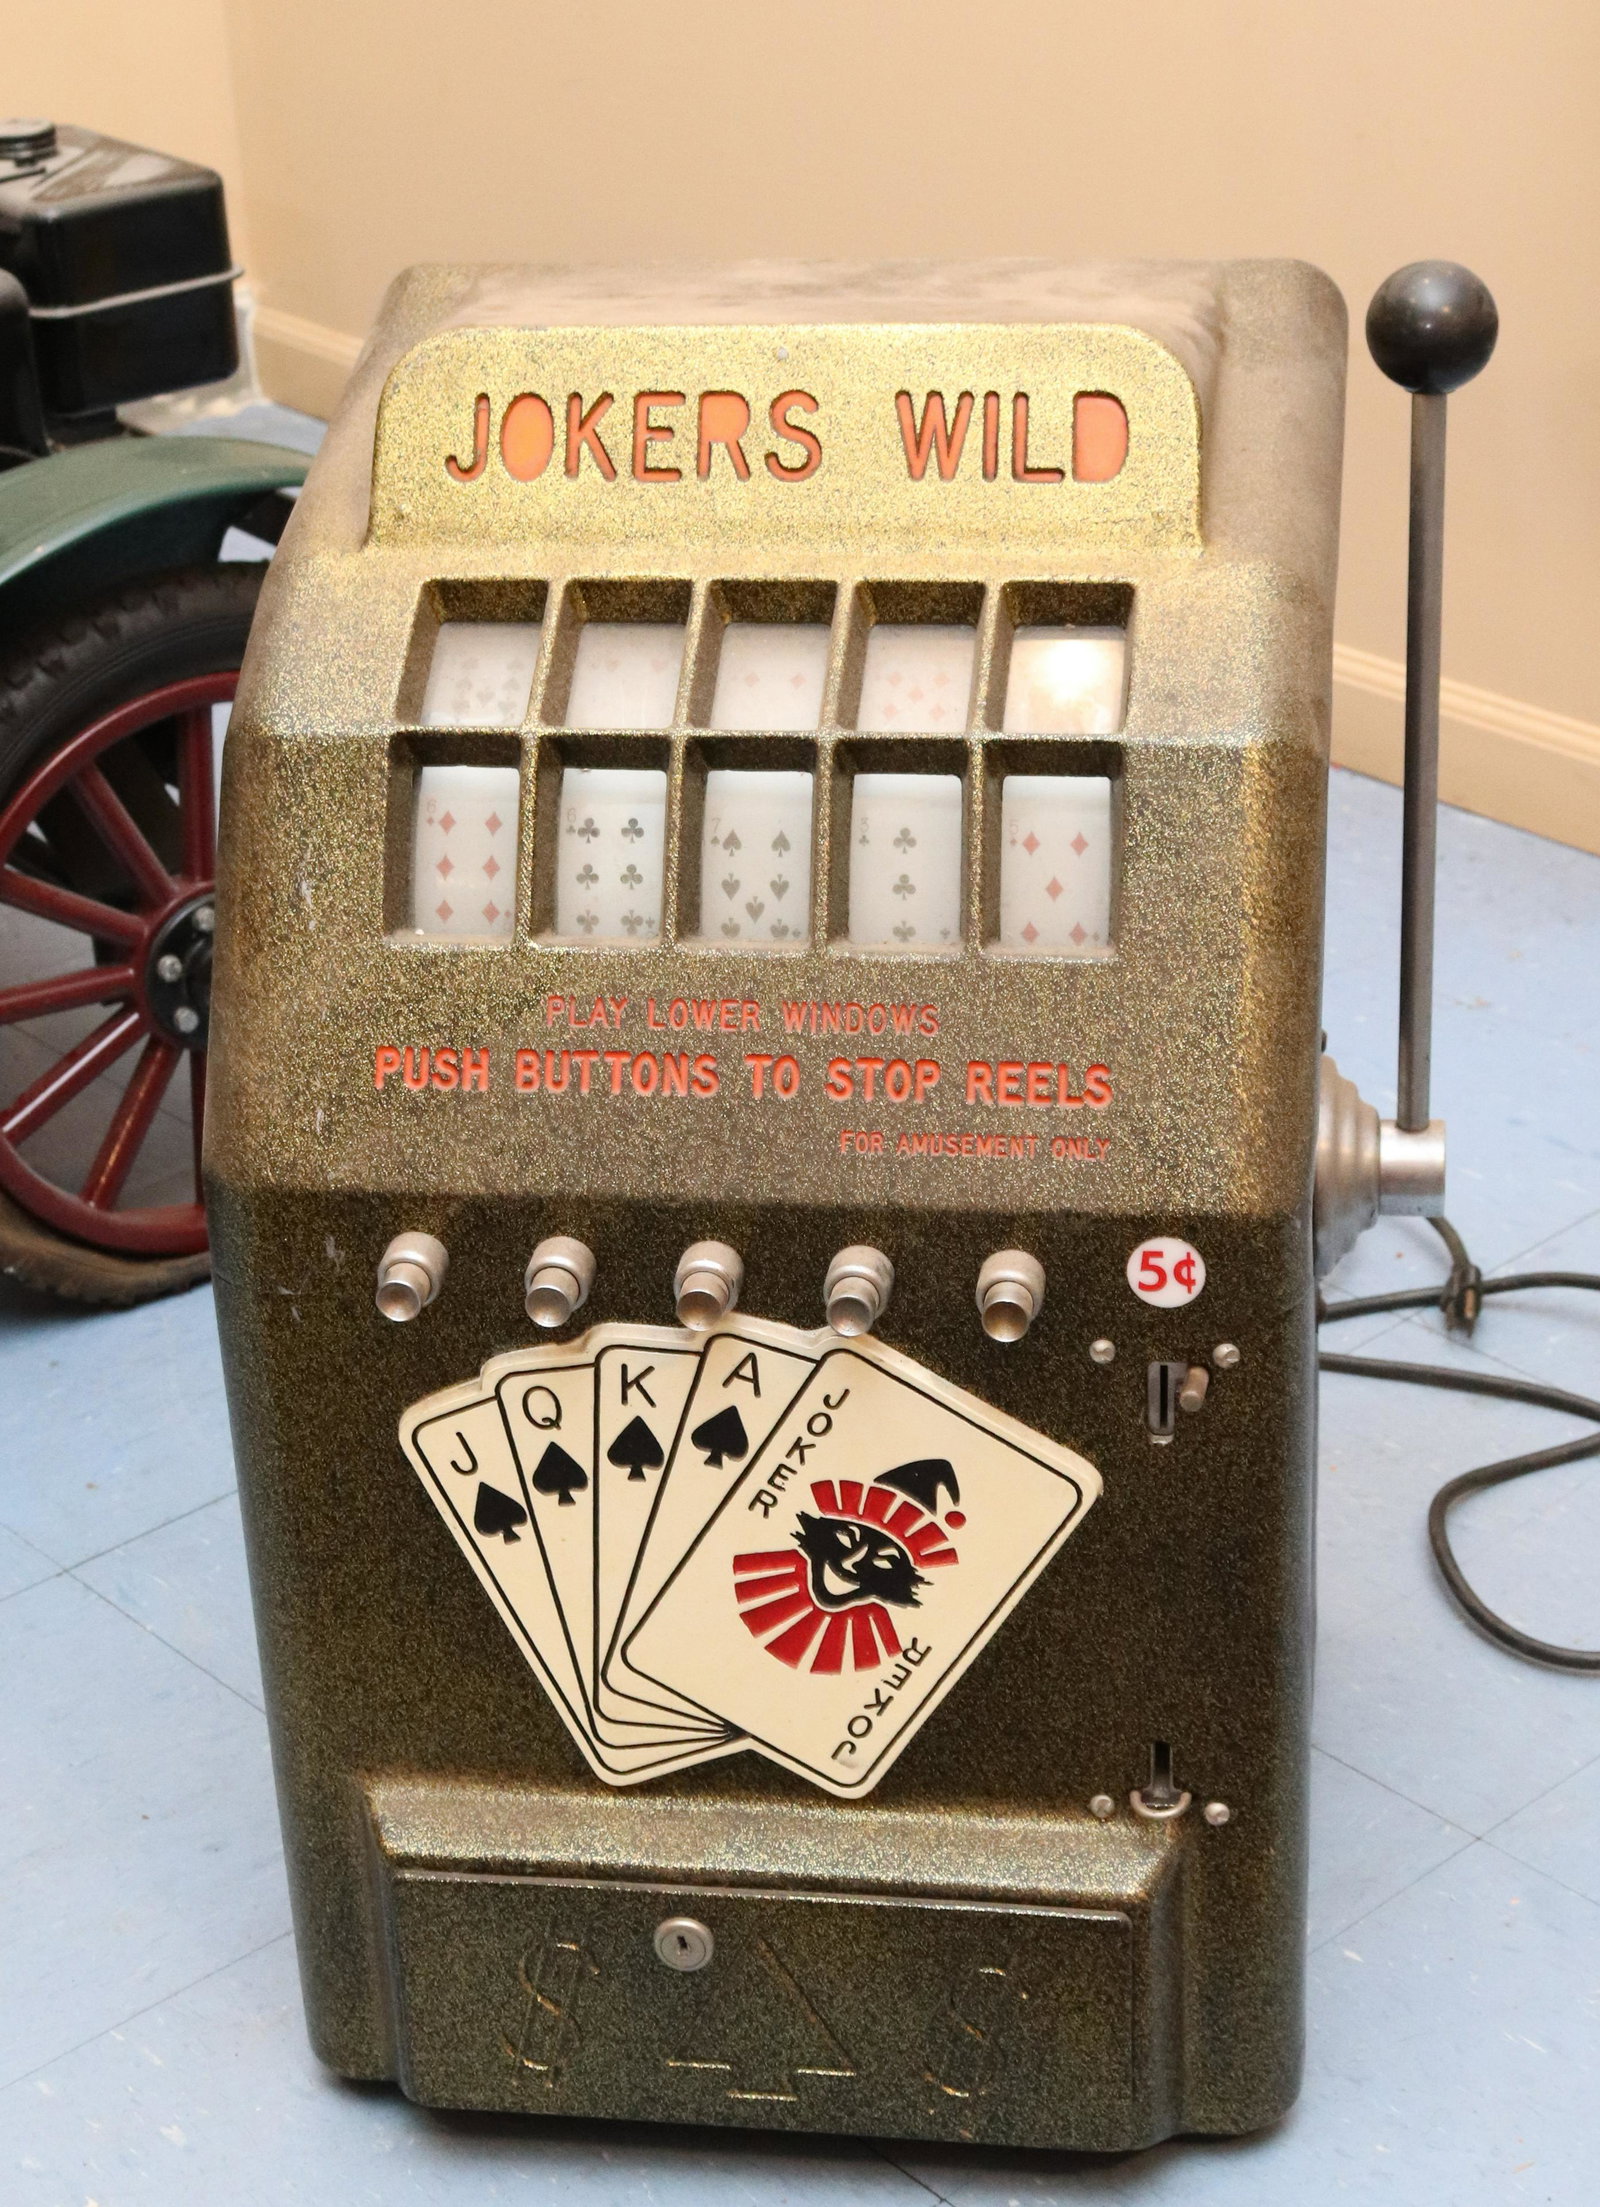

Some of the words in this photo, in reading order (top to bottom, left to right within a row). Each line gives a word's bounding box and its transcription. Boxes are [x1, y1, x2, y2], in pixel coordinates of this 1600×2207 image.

[444, 390, 823, 484] JOKERS
[893, 389, 1130, 484] WILD
[425, 799, 437, 815] 6
[566, 807, 578, 824] 6
[710, 817, 722, 834] 7
[860, 817, 870, 834] 3
[545, 993, 629, 1030] PLAY
[647, 997, 761, 1032] LOWER
[783, 1000, 940, 1036] WINDOWS
[373, 1045, 491, 1092] PUSH
[514, 1047, 720, 1096] BUTTONS
[743, 1053, 801, 1099] TO
[824, 1056, 942, 1105] STOP
[965, 1060, 1114, 1109] REELS
[839, 1129, 885, 1155] FOR
[896, 1131, 1038, 1159] AMUSEMENT
[1051, 1135, 1111, 1162] ONLY
[1137, 1250, 1197, 1294] 5¢
[620, 1363, 657, 1408] K
[721, 1352, 761, 1398] A
[521, 1385, 563, 1430] Q
[450, 1431, 479, 1476] J
[748, 1388, 850, 1519] JOKER
[831, 1637, 932, 1760] JOKER
